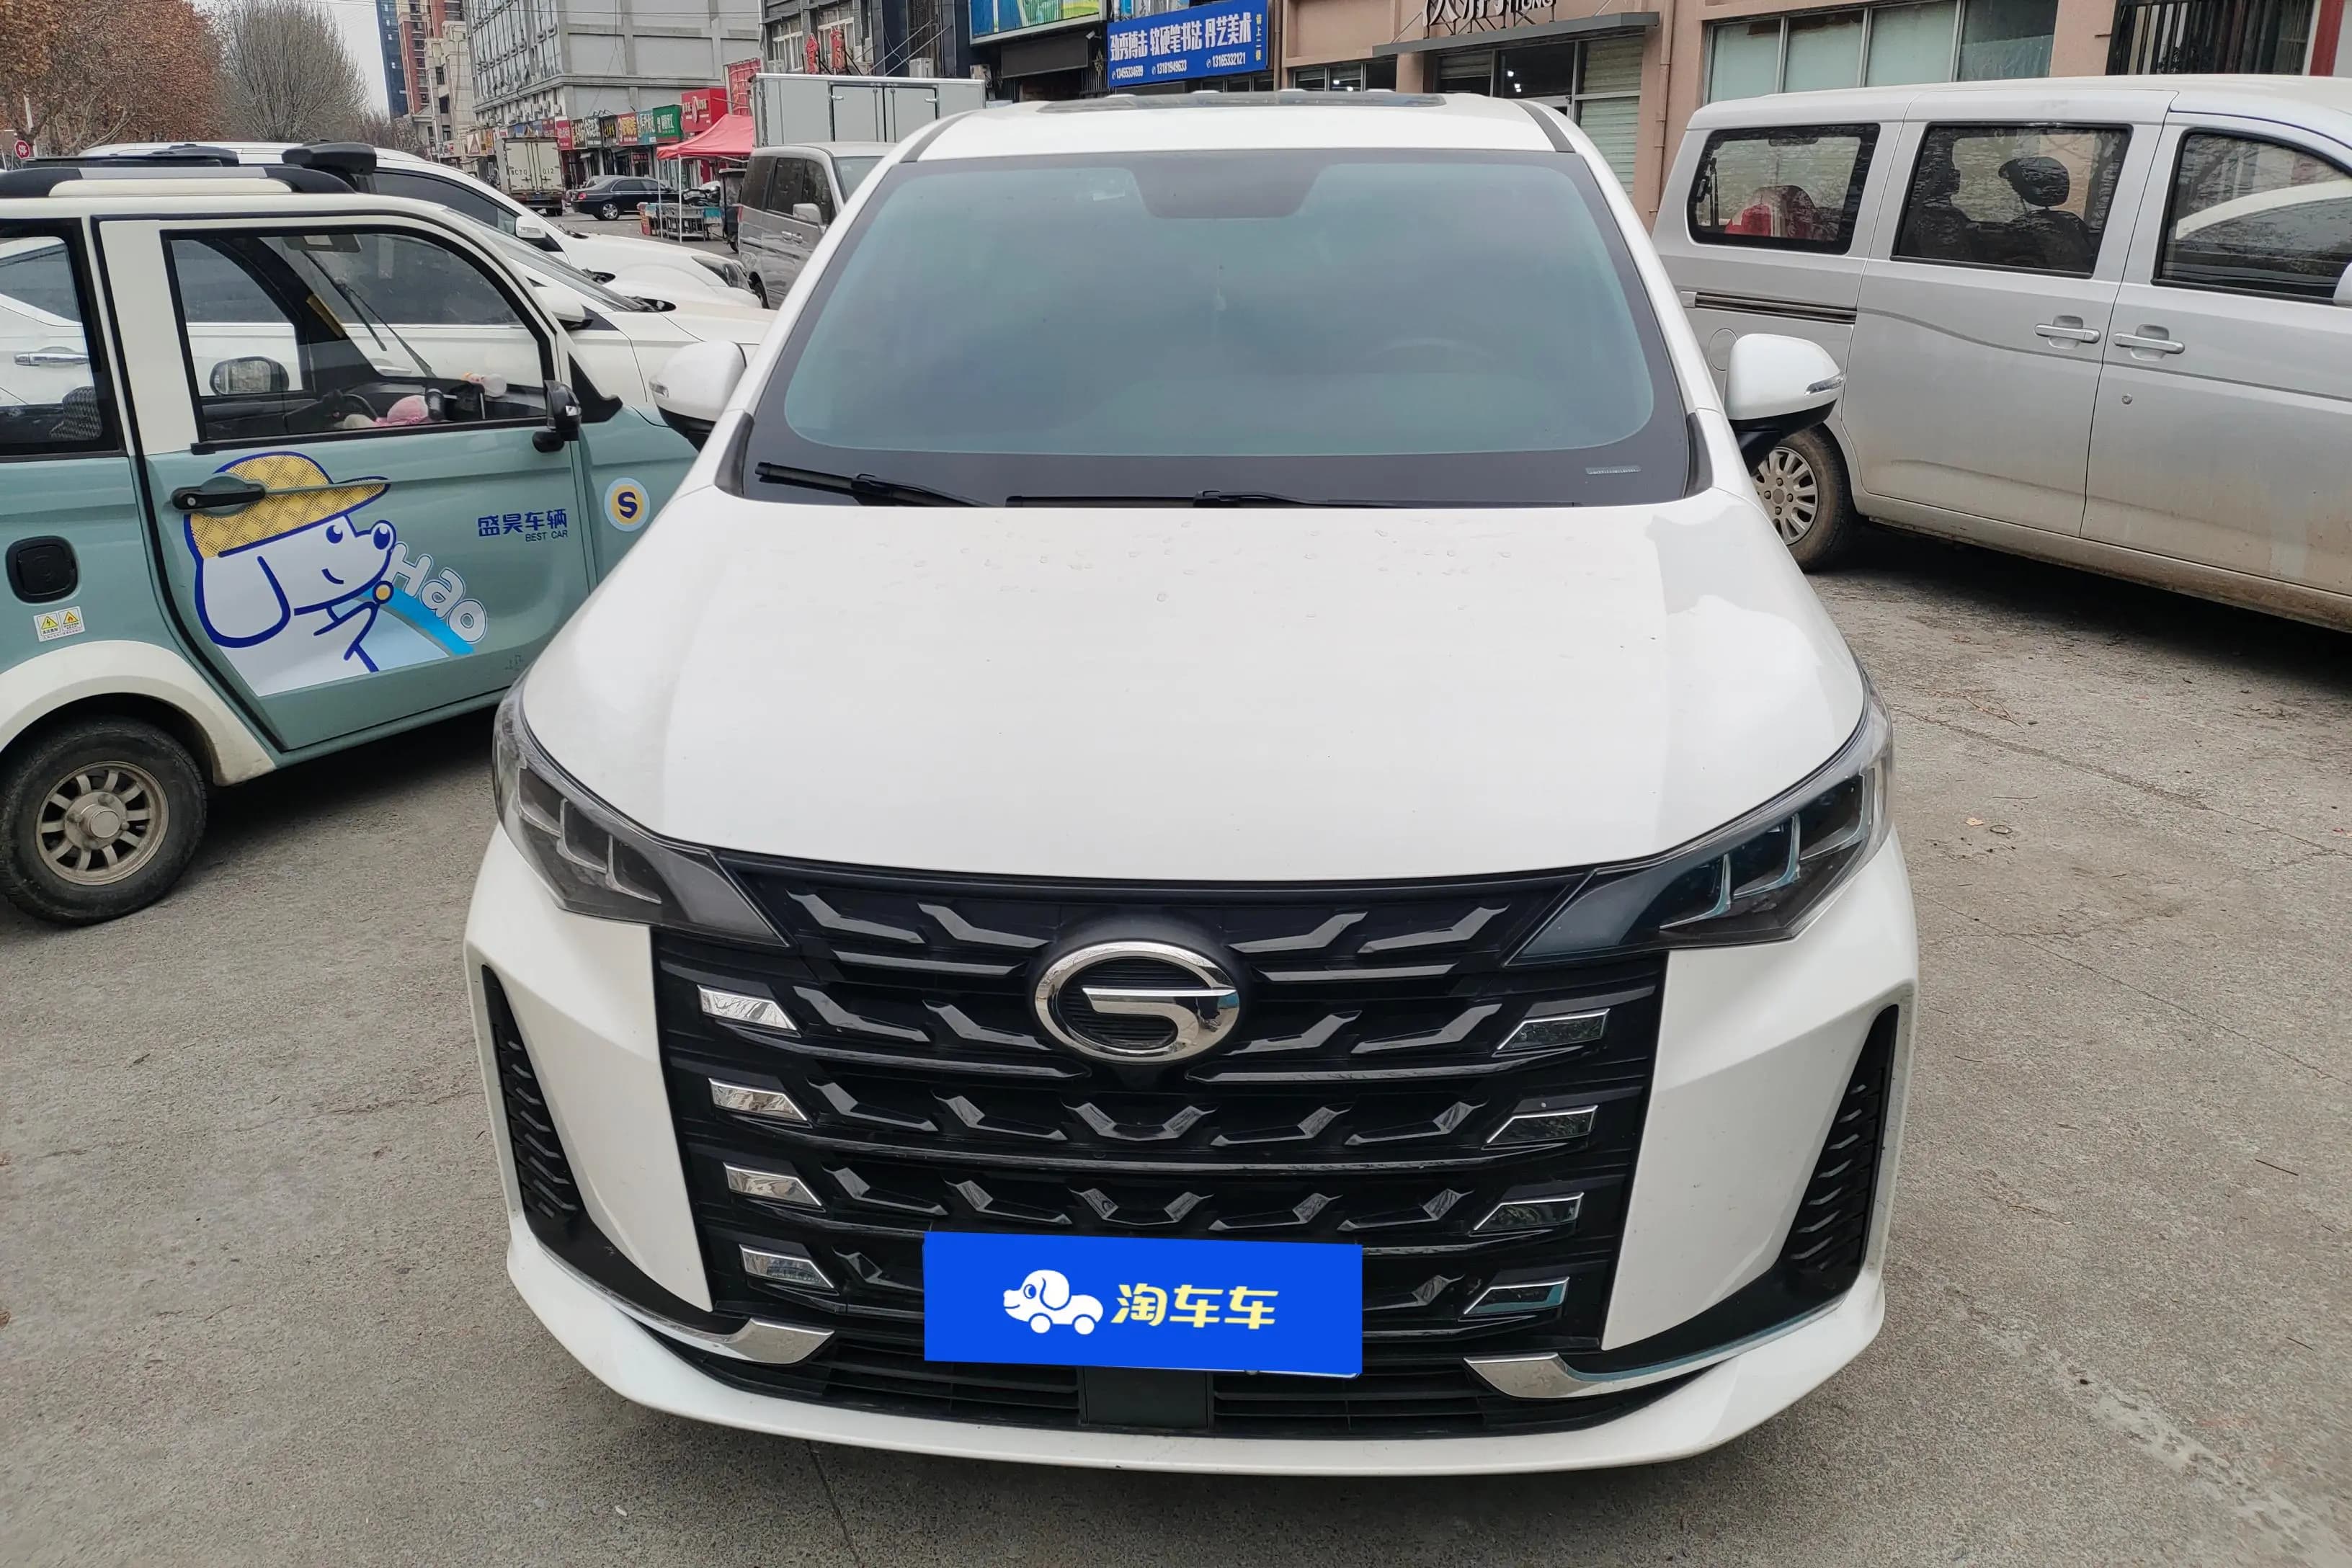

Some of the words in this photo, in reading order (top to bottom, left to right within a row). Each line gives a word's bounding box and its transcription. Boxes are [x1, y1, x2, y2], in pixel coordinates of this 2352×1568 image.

[1150, 20, 1202, 56] 软硬笔书法
[1205, 12, 1252, 49] 丹艺美术
[618, 491, 638, 519] S
[478, 509, 568, 537] 盛昊车辆
[525, 532, 548, 542] BEST
[551, 530, 569, 539] CAR
[380, 542, 488, 643] Hao
